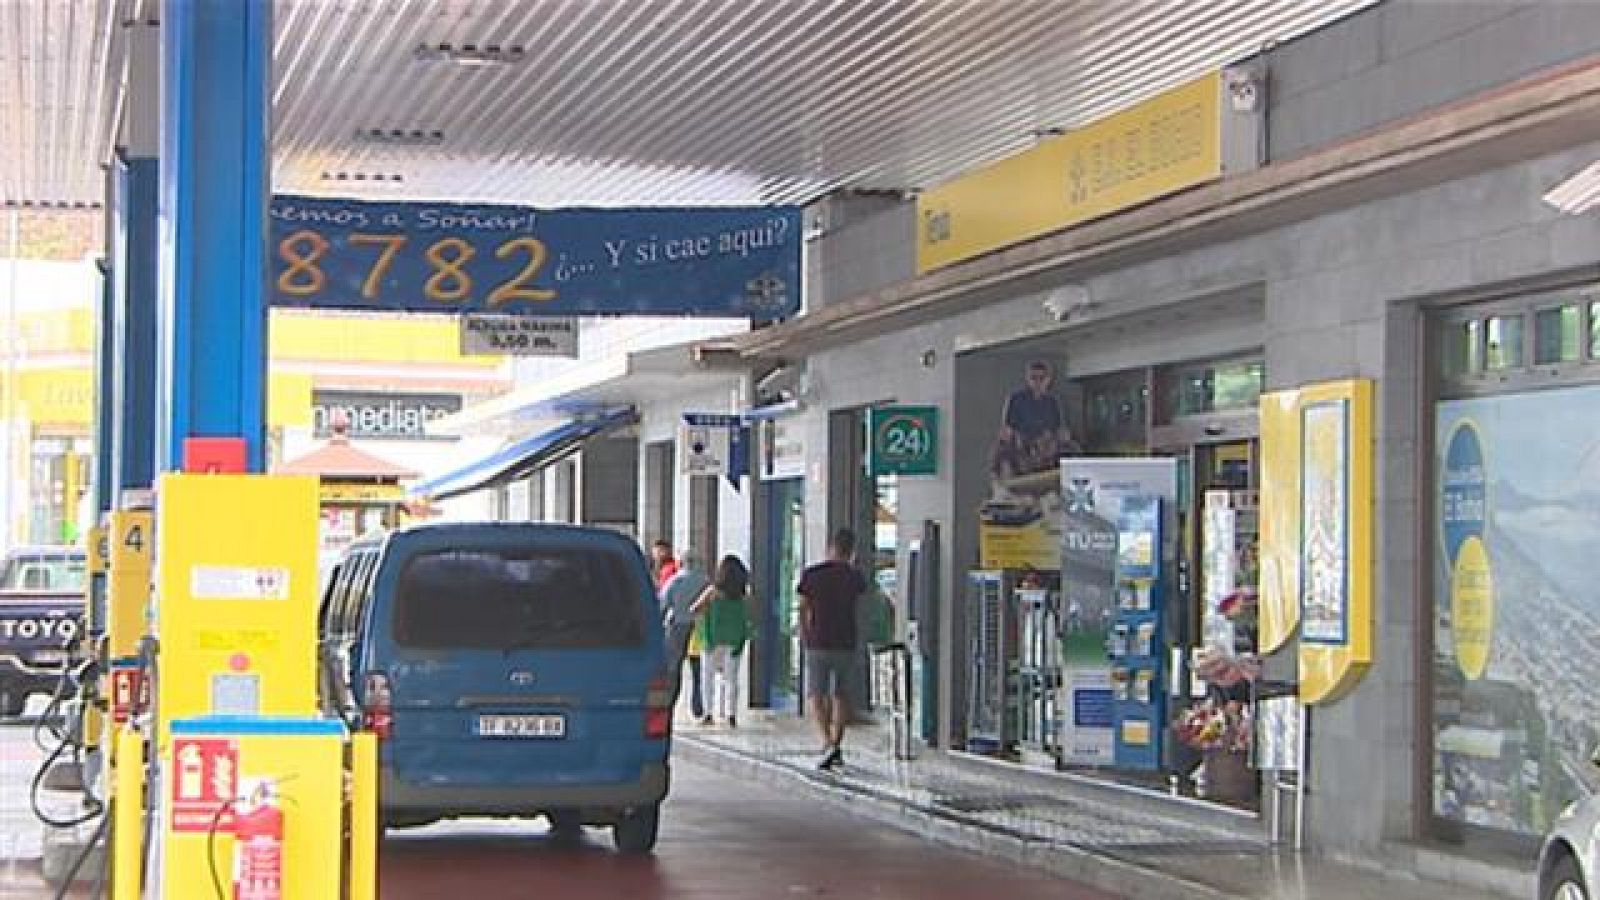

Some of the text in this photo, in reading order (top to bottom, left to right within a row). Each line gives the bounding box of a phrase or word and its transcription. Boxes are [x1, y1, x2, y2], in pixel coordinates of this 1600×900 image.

[604, 238, 626, 267] Y
[664, 236, 711, 261] cae
[277, 229, 557, 306] 8782
[125, 524, 141, 552] 4
